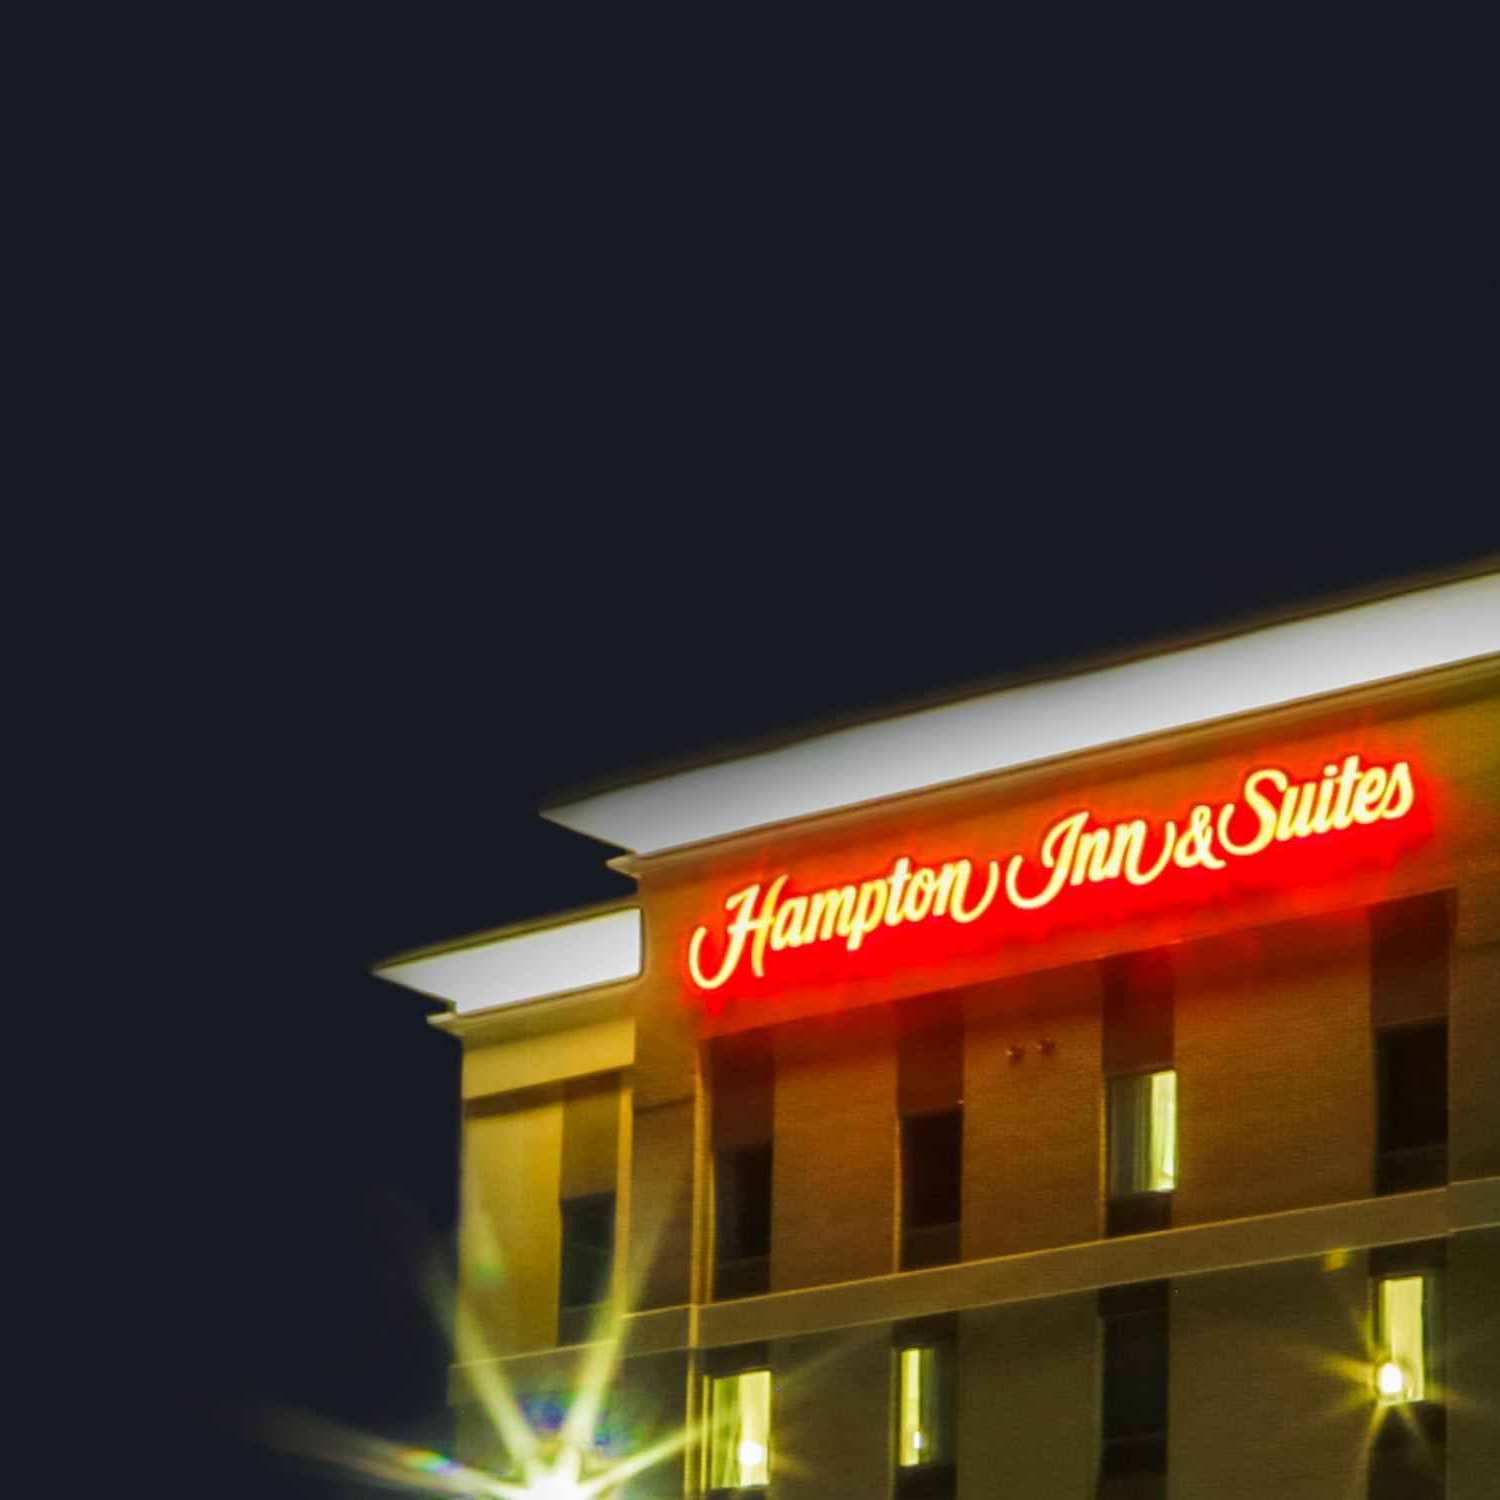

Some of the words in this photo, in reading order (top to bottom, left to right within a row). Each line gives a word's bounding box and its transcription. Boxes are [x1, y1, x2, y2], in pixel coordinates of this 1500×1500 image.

[688, 856, 999, 989] Hampton
[1006, 810, 1176, 910] Inn
[1173, 804, 1226, 870] &
[1217, 754, 1414, 856] Suites
